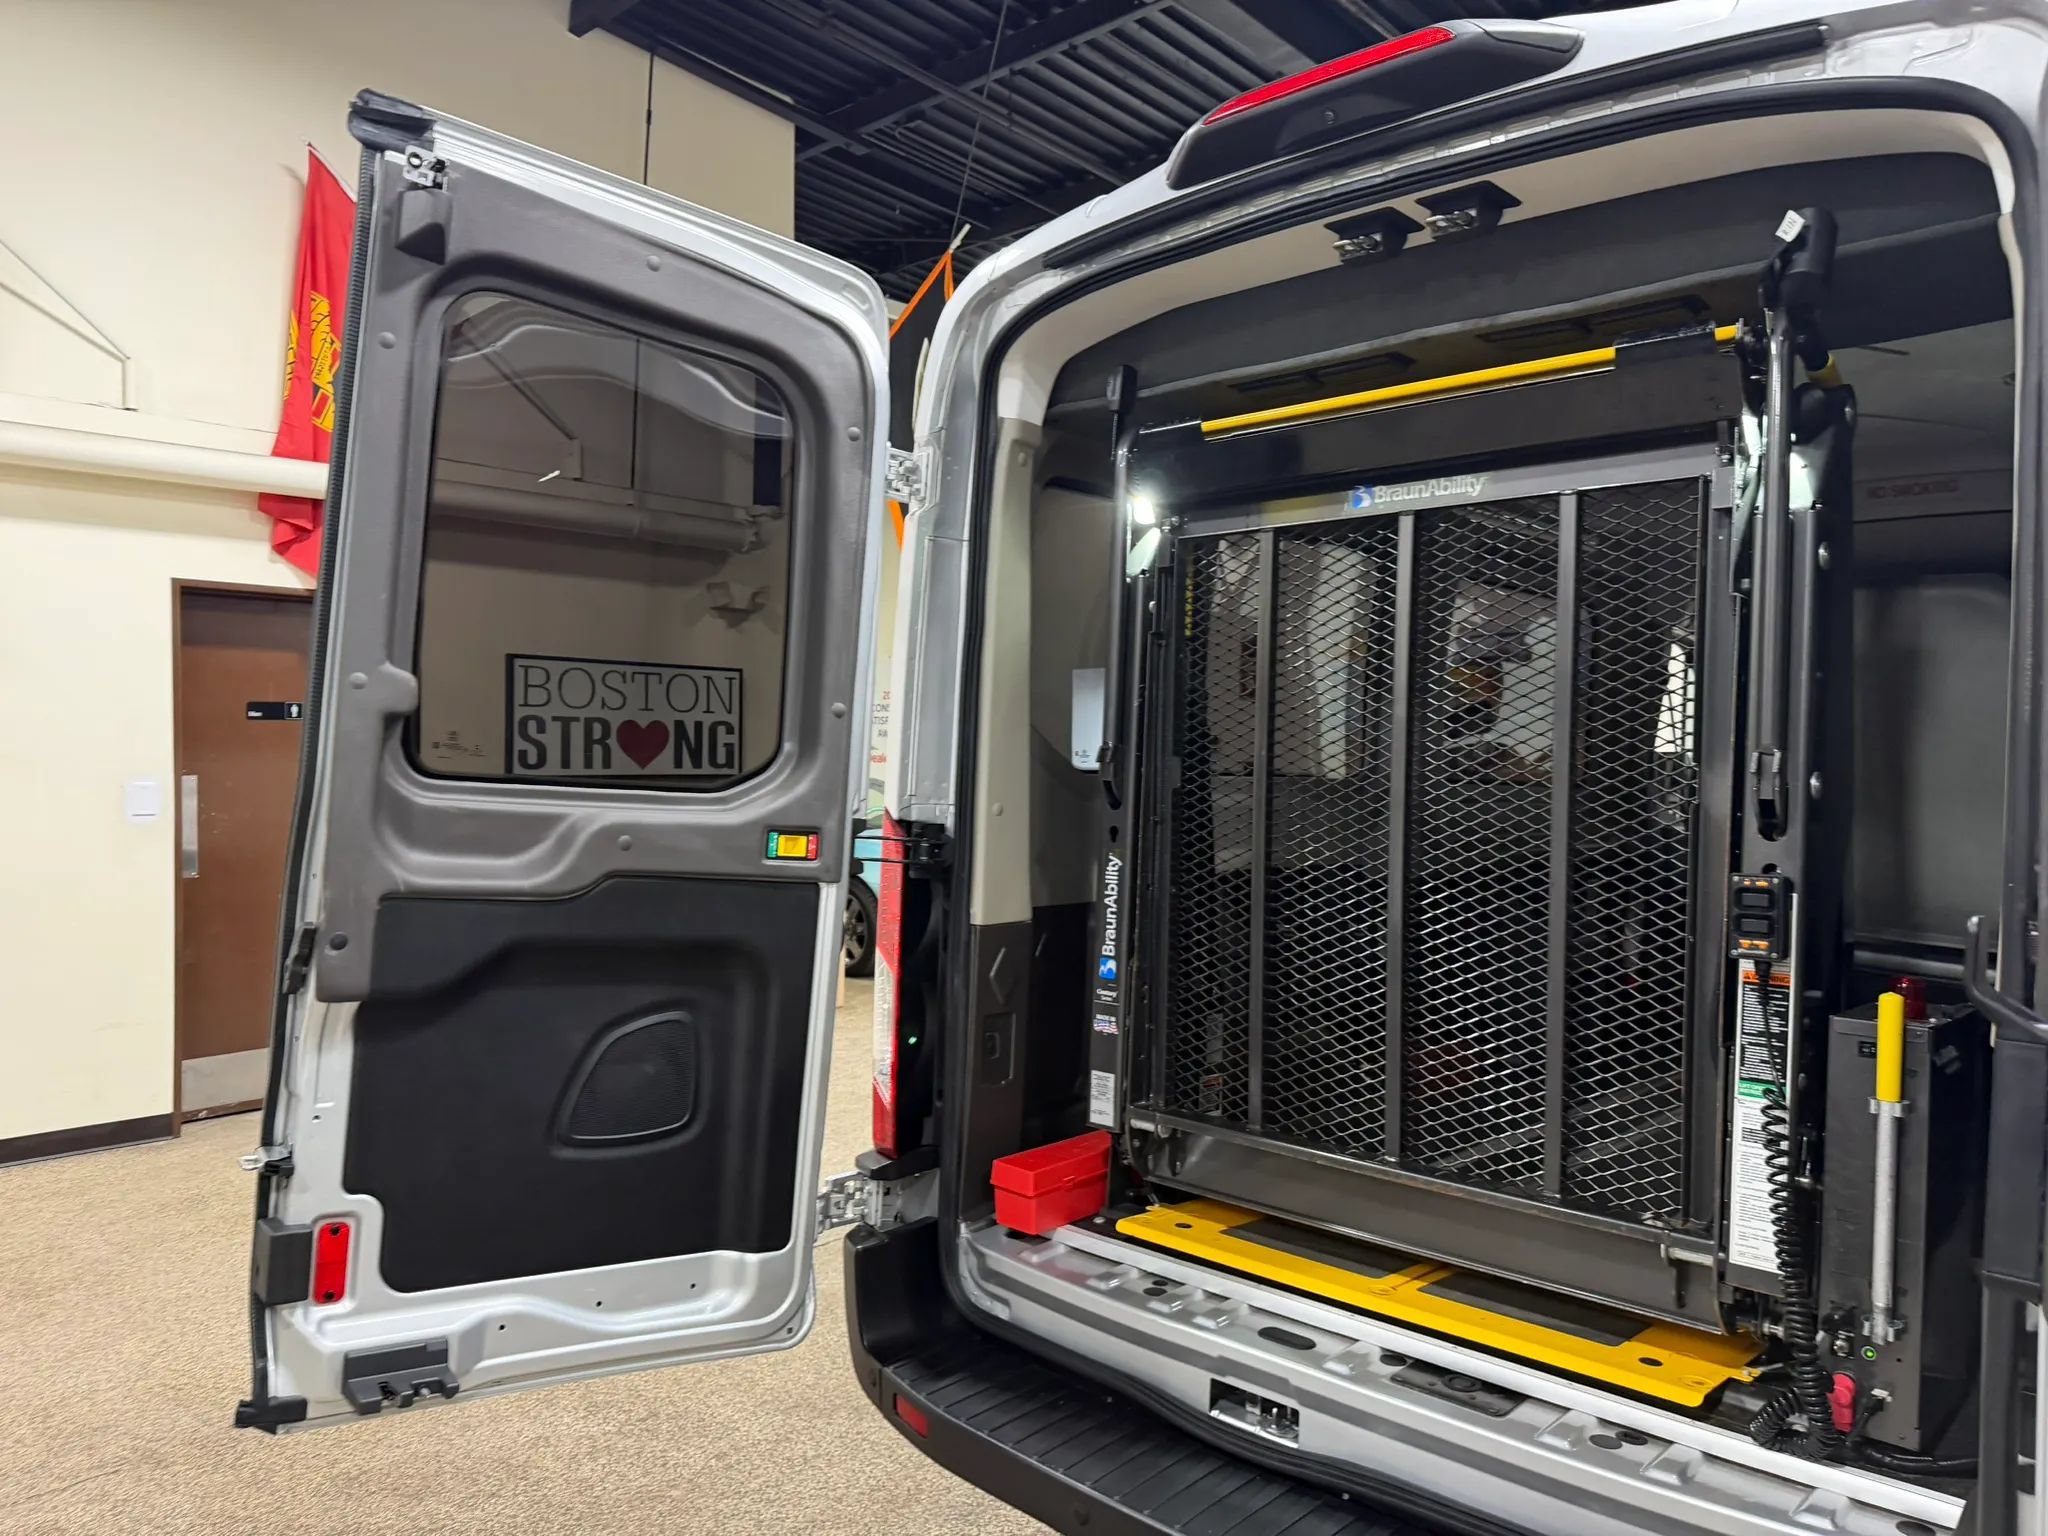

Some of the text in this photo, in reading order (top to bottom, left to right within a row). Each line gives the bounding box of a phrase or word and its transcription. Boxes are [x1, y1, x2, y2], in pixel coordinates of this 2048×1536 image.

[1374, 475, 1486, 504] BraunAbility
[518, 664, 737, 714] BOSTON
[518, 714, 735, 770] STRNG
[1101, 854, 1122, 957] BraunAbility
